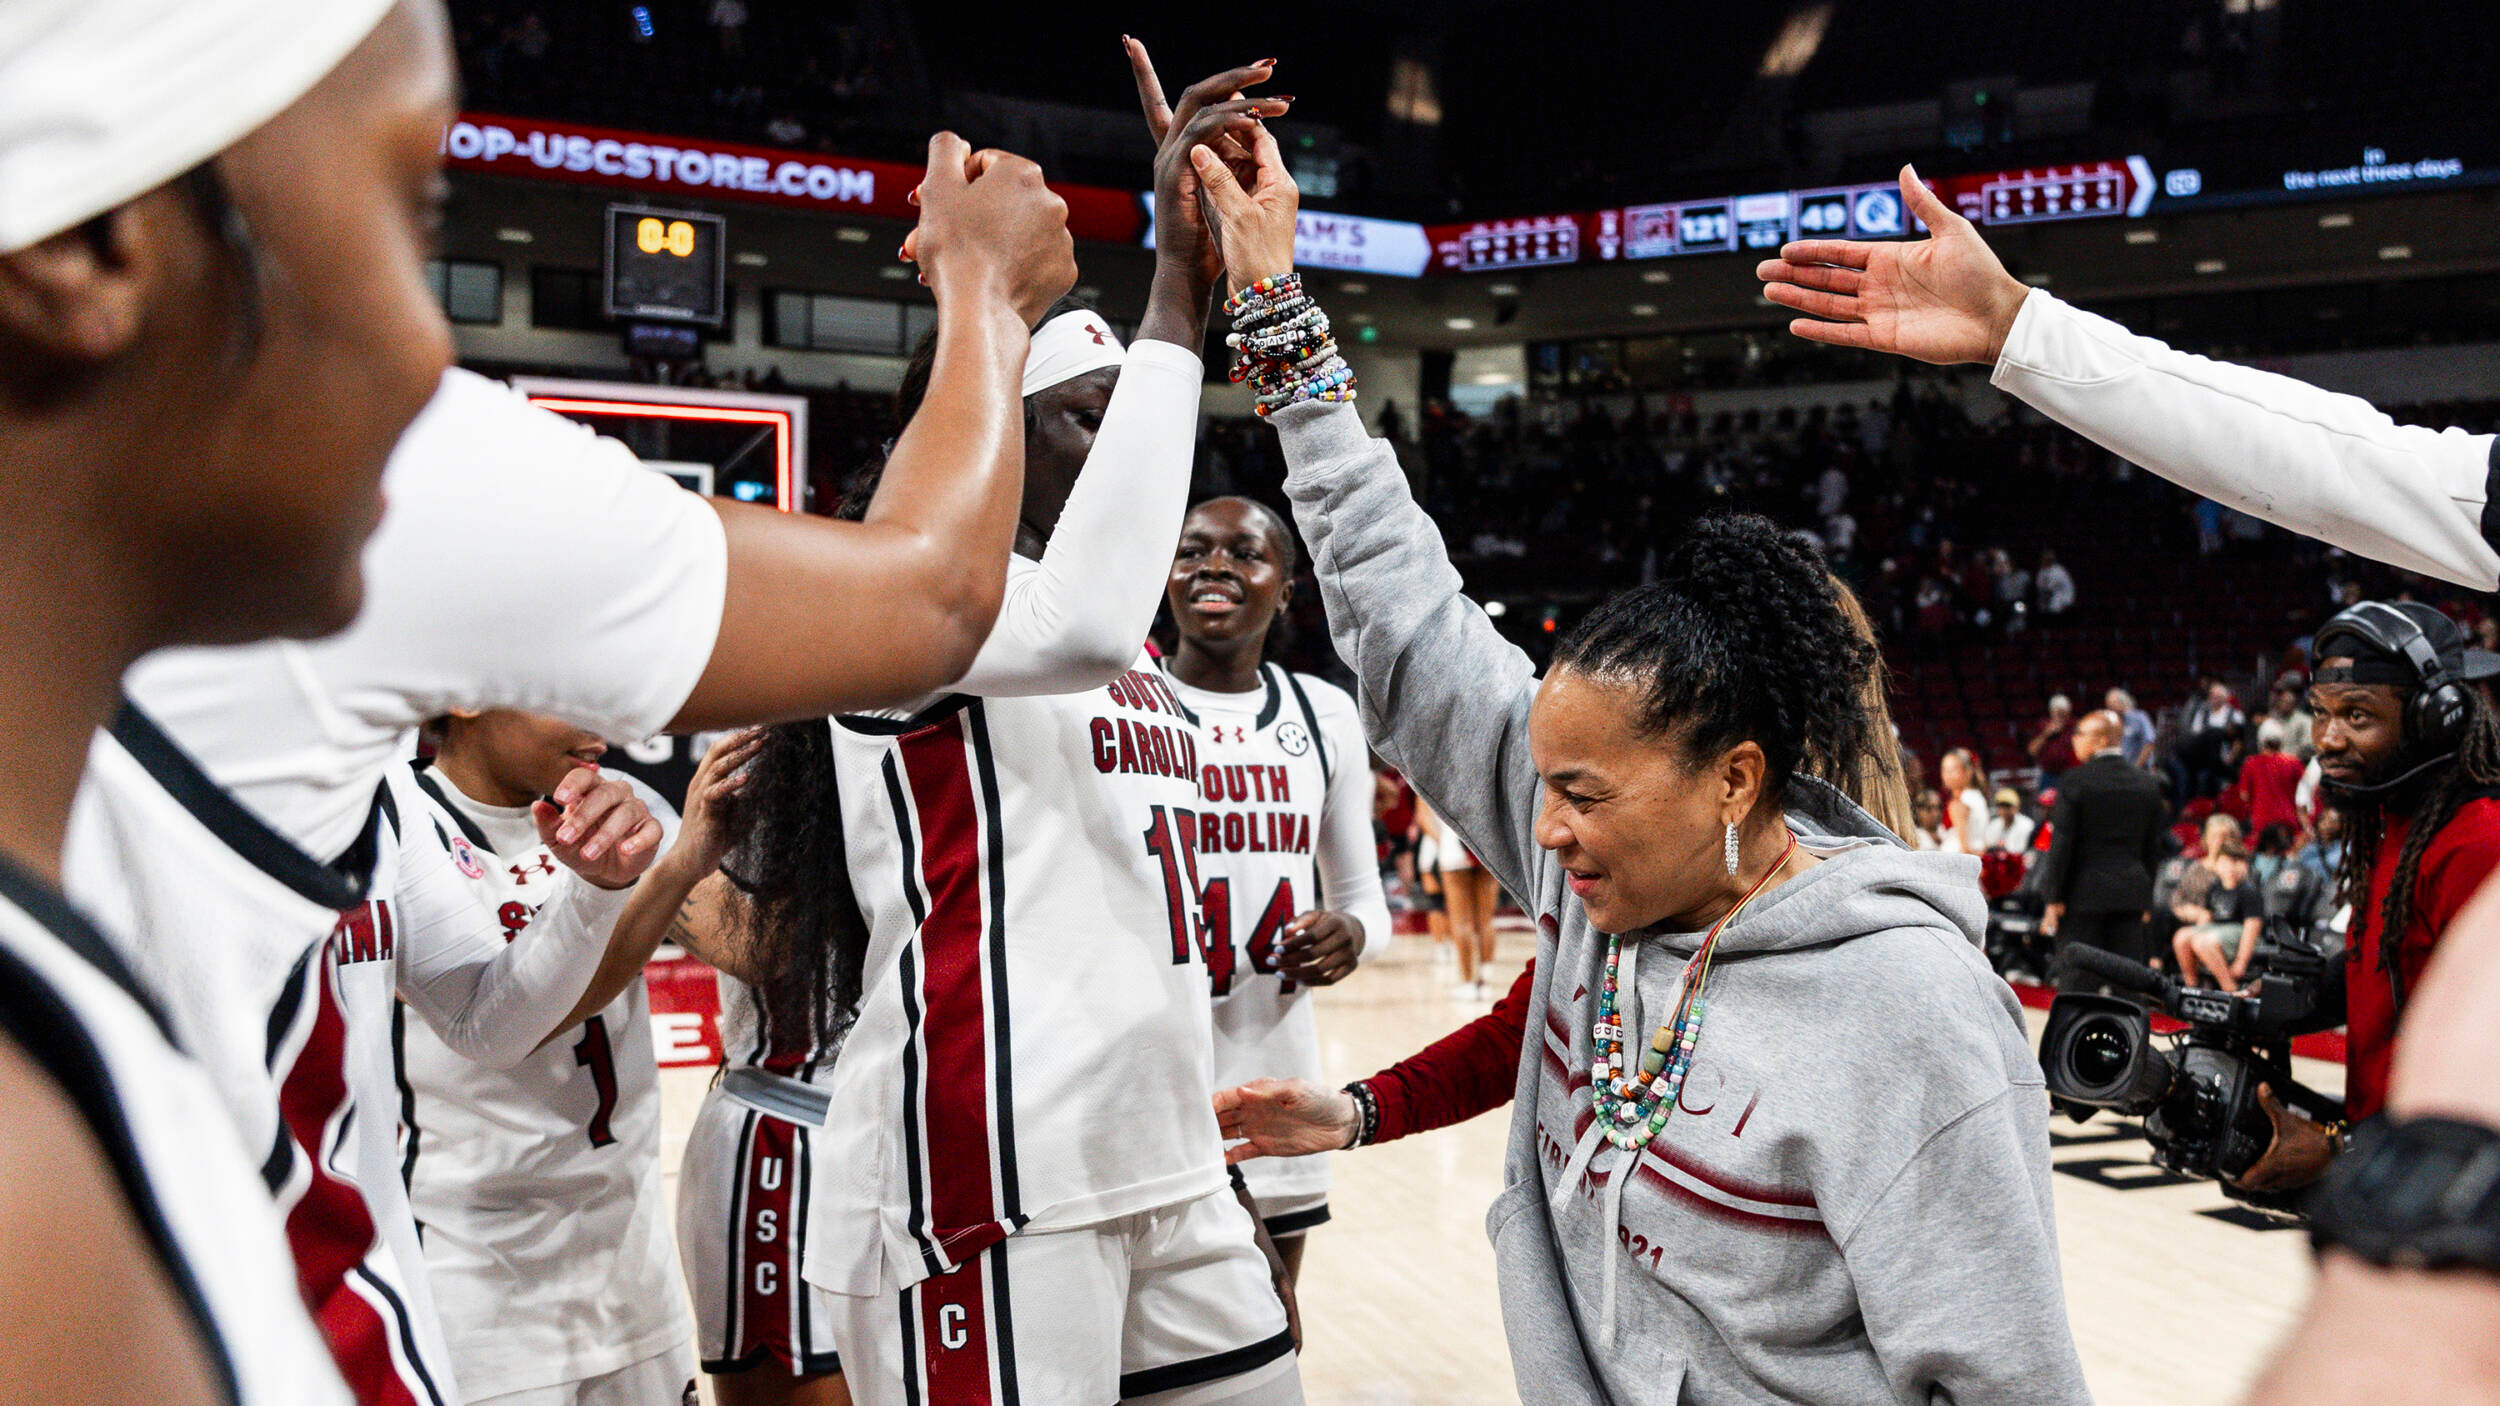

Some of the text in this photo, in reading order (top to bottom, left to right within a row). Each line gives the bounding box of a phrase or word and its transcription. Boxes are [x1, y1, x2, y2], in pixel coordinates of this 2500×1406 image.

[441, 121, 874, 204] OP-USCSTORE.COM
[2284, 157, 2463, 191] the next three days
[2364, 147, 2386, 166] in
[1681, 214, 1729, 243] 121
[1198, 764, 1291, 803] OUTH
[1199, 812, 1310, 855] ROLINA
[573, 1013, 619, 1149] 1
